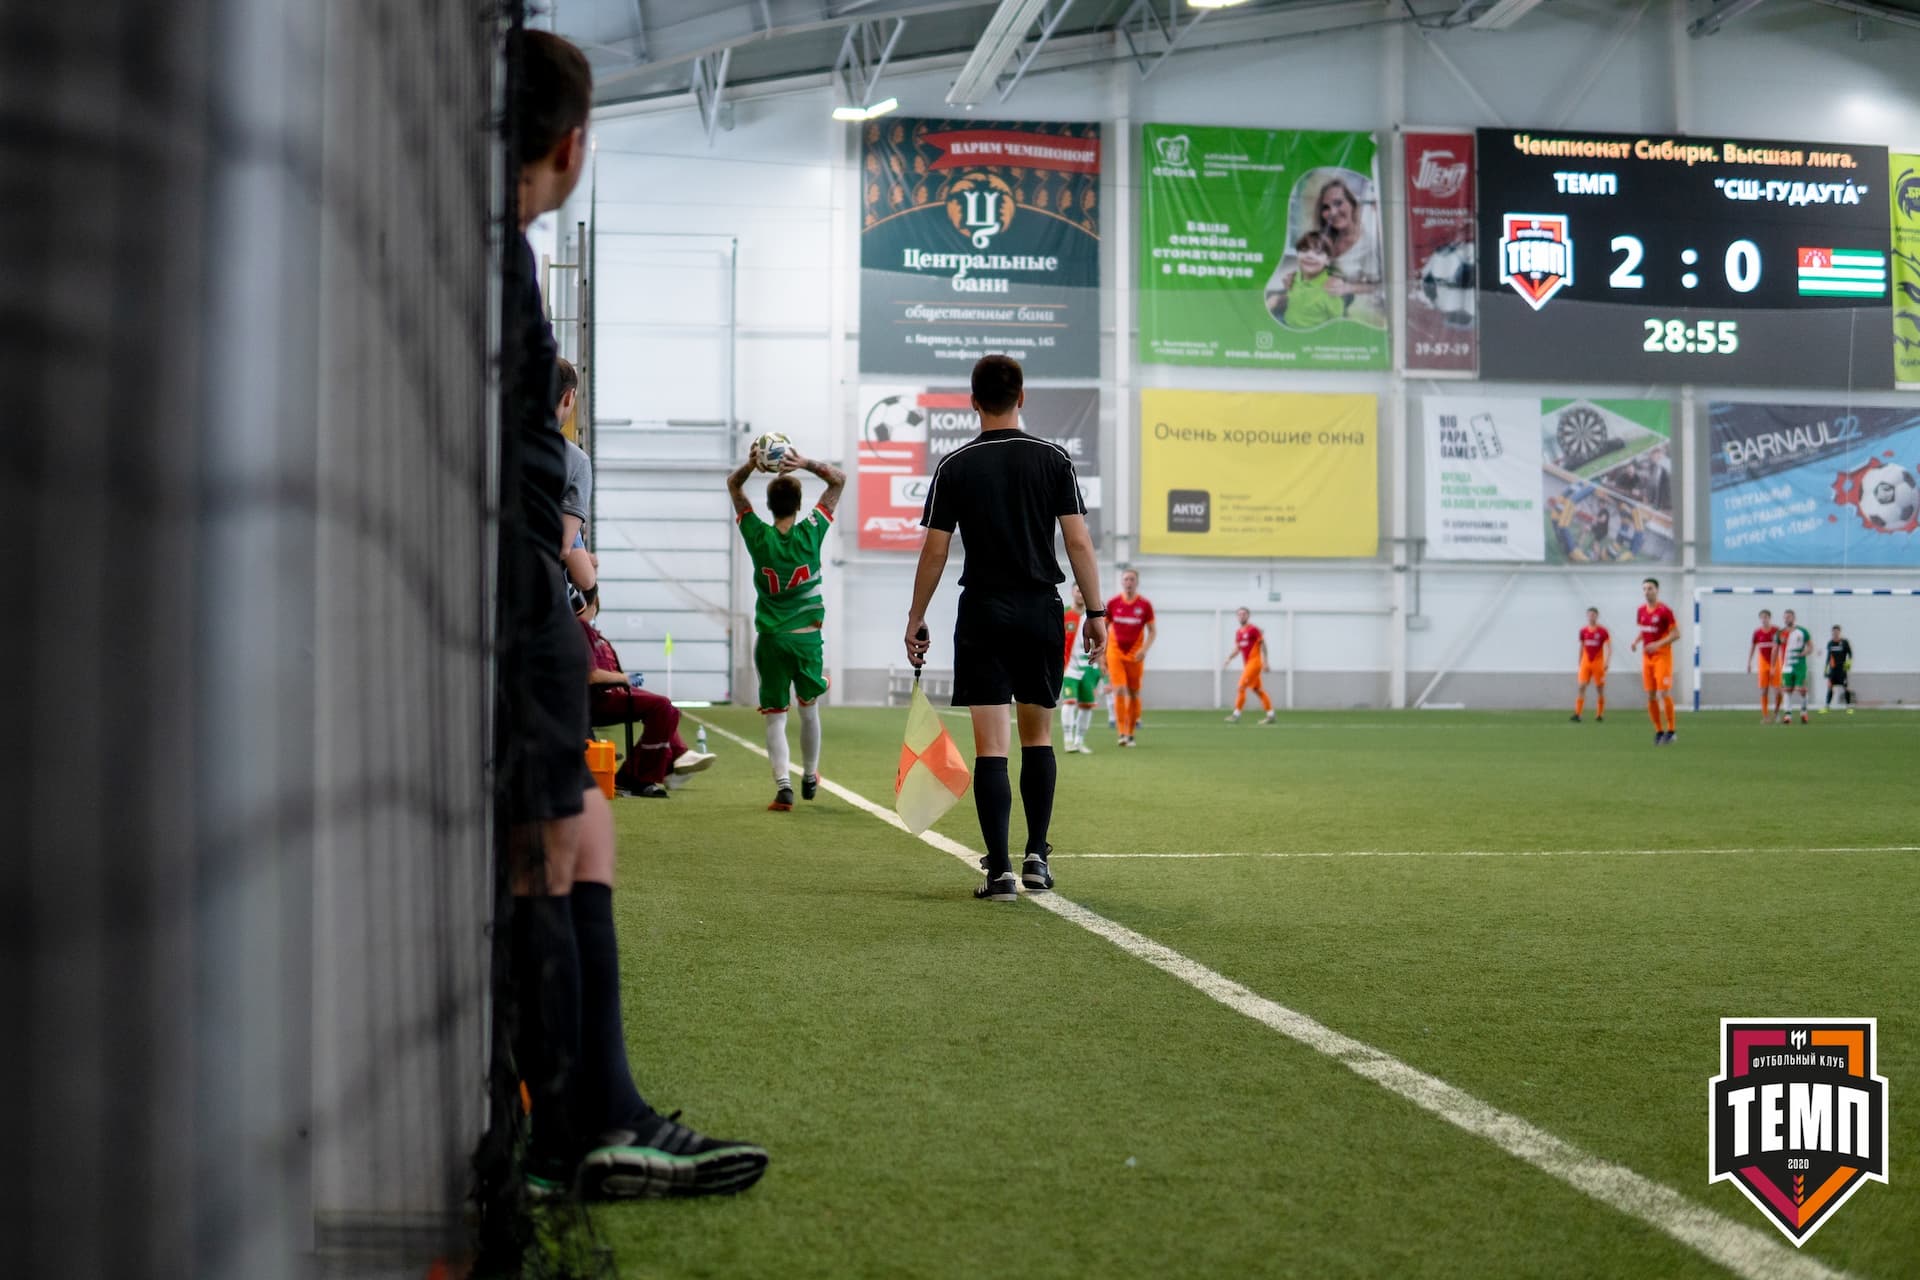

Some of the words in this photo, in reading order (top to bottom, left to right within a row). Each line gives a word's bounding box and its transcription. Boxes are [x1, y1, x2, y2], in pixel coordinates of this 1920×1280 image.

[951, 142, 1000, 155] ПАРИМ
[1514, 135, 1631, 160] Чемпионат
[1635, 140, 1718, 166] Сибири.
[1723, 144, 1804, 166] Высшая
[1807, 150, 1857, 169] лига.
[1553, 172, 1617, 195] ТЕМП
[1187, 221, 1229, 234] Ваша
[1169, 233, 1247, 249] семейная
[903, 248, 1058, 275] Центральные
[1152, 248, 1263, 263] стоматология
[1608, 235, 1644, 289] 2
[1723, 239, 1762, 293] 0
[1162, 263, 1171, 275] в
[1177, 262, 1254, 279] Барнауле
[951, 274, 1009, 293] бани
[904, 304, 1014, 322] общественные
[1017, 306, 1055, 322] бани
[1643, 318, 1739, 355] 28:55
[1154, 422, 1217, 442] Очень
[1223, 428, 1312, 447] хорошие
[1317, 430, 1365, 445] окна
[1172, 502, 1205, 516] АКТО
